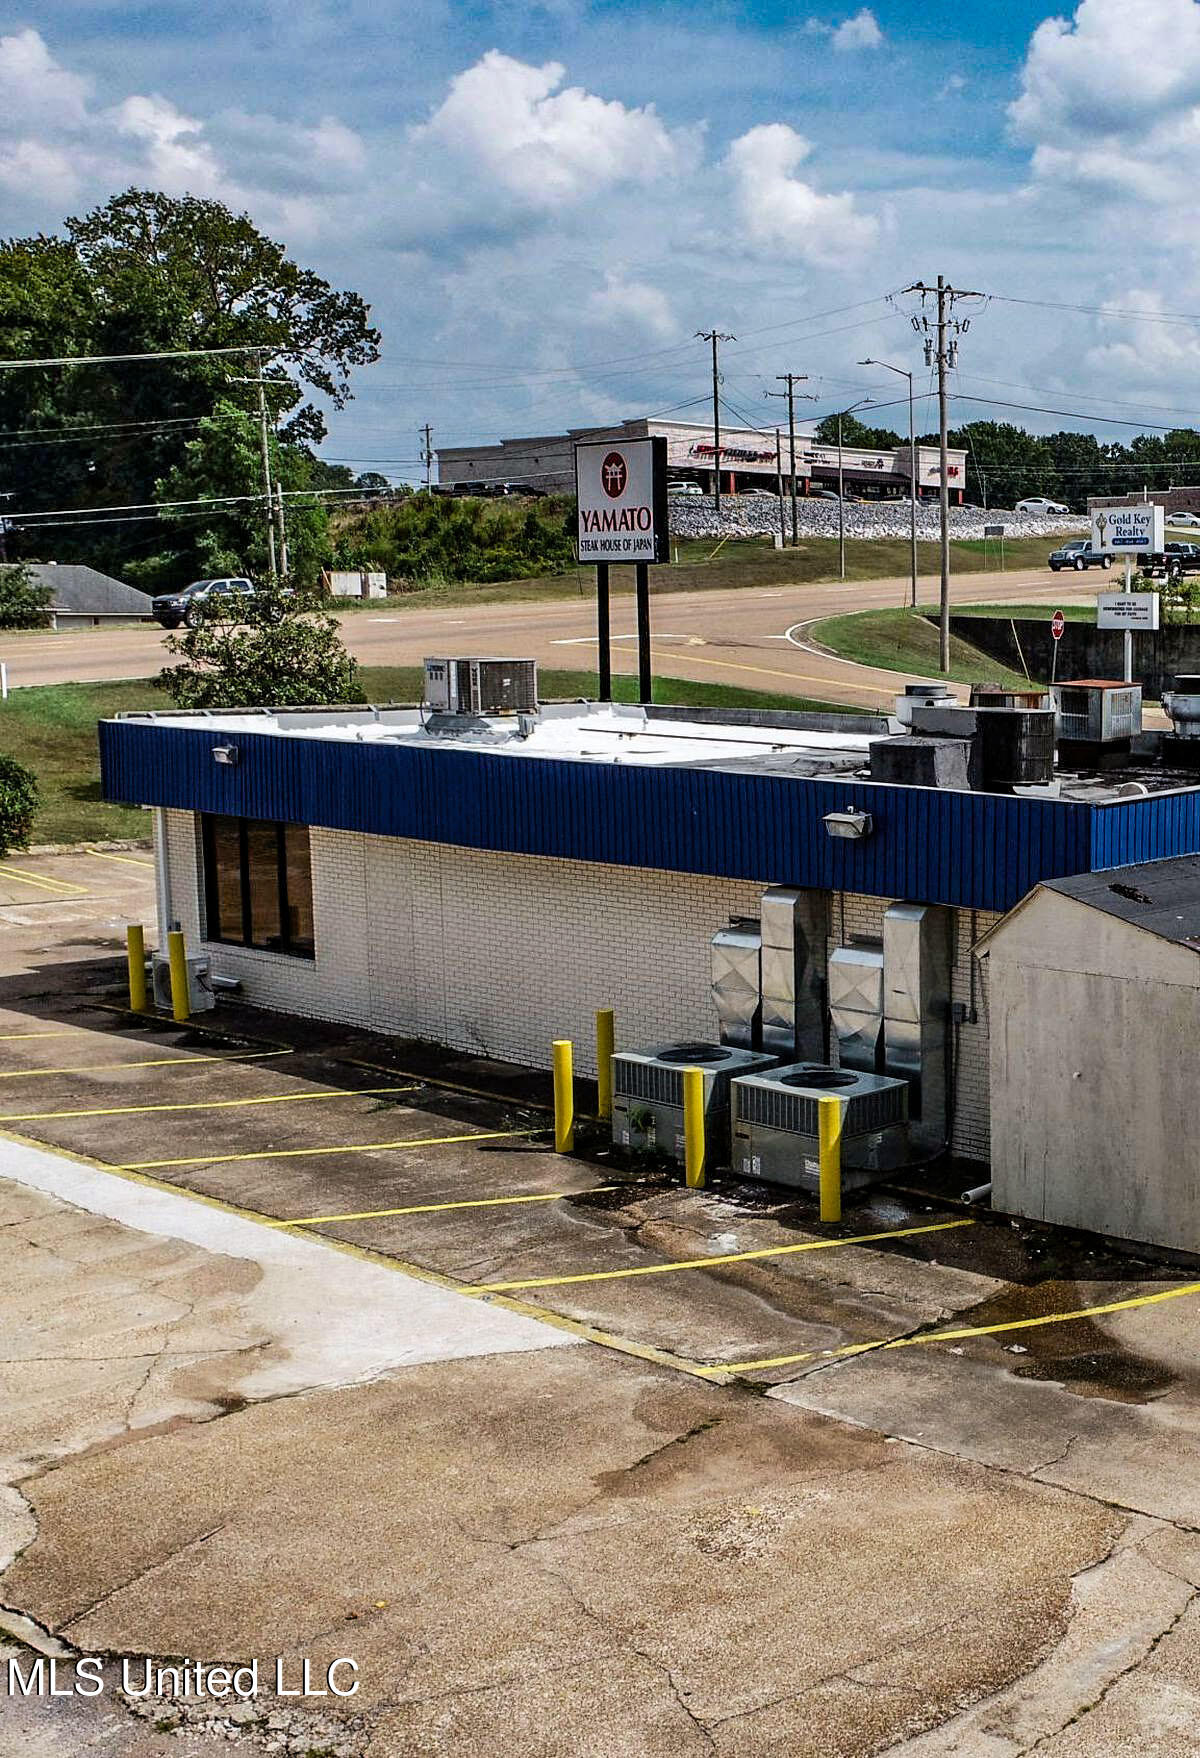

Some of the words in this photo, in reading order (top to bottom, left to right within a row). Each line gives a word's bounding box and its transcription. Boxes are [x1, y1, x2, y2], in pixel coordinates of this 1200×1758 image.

[580, 506, 652, 533] YAMATO
[1108, 513, 1131, 526] Gold
[1133, 513, 1152, 527] Key
[1115, 525, 1145, 537] Realty
[580, 539, 599, 553] STEAK
[600, 539, 622, 552] HOUSE
[622, 538, 632, 552] OF
[632, 537, 653, 553] JAPAN
